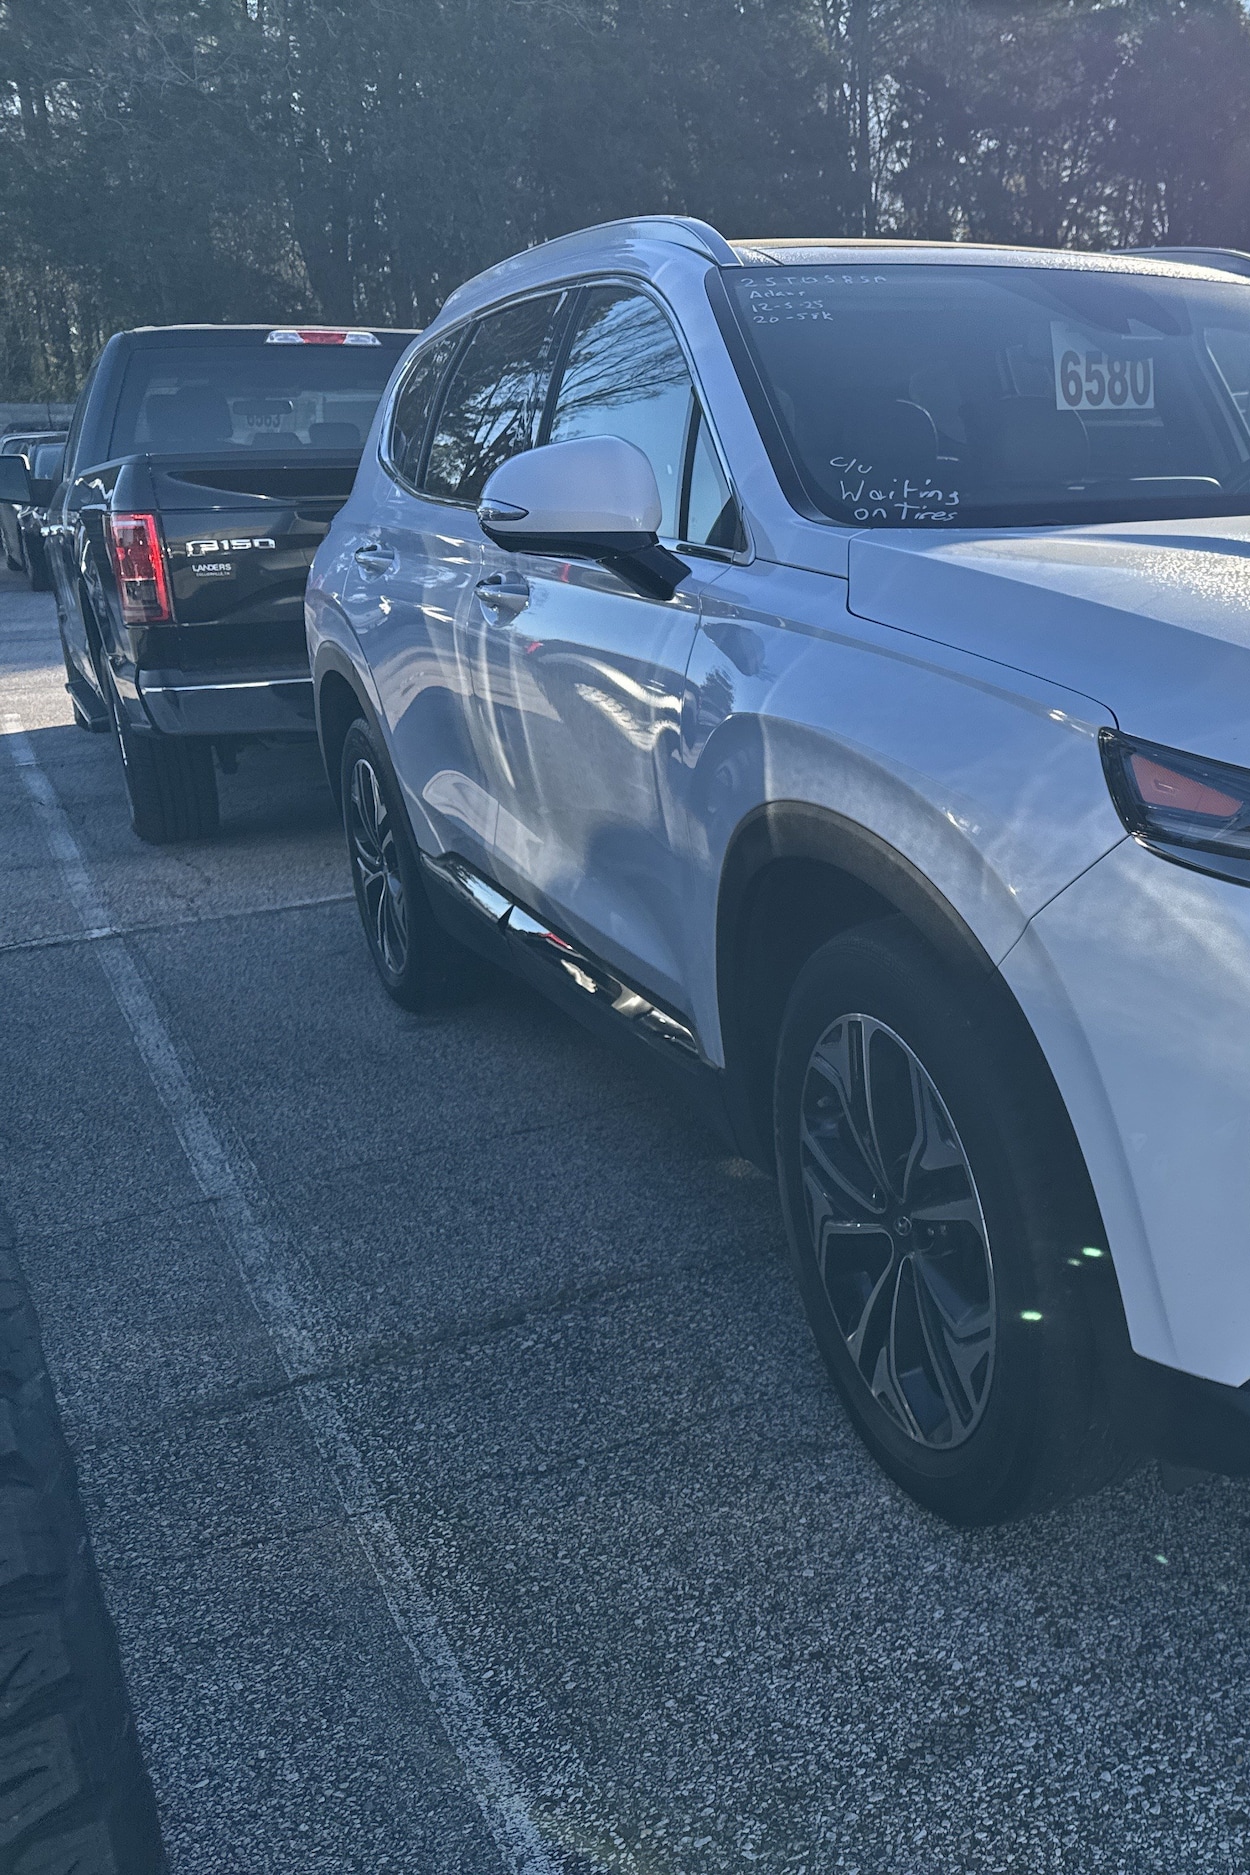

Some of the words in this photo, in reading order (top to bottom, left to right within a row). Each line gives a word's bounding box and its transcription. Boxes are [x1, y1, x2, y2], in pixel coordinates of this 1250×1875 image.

[1060, 350, 1151, 407] 6580
[840, 479, 960, 506] Waiting
[191, 563, 232, 572] LANDERS
